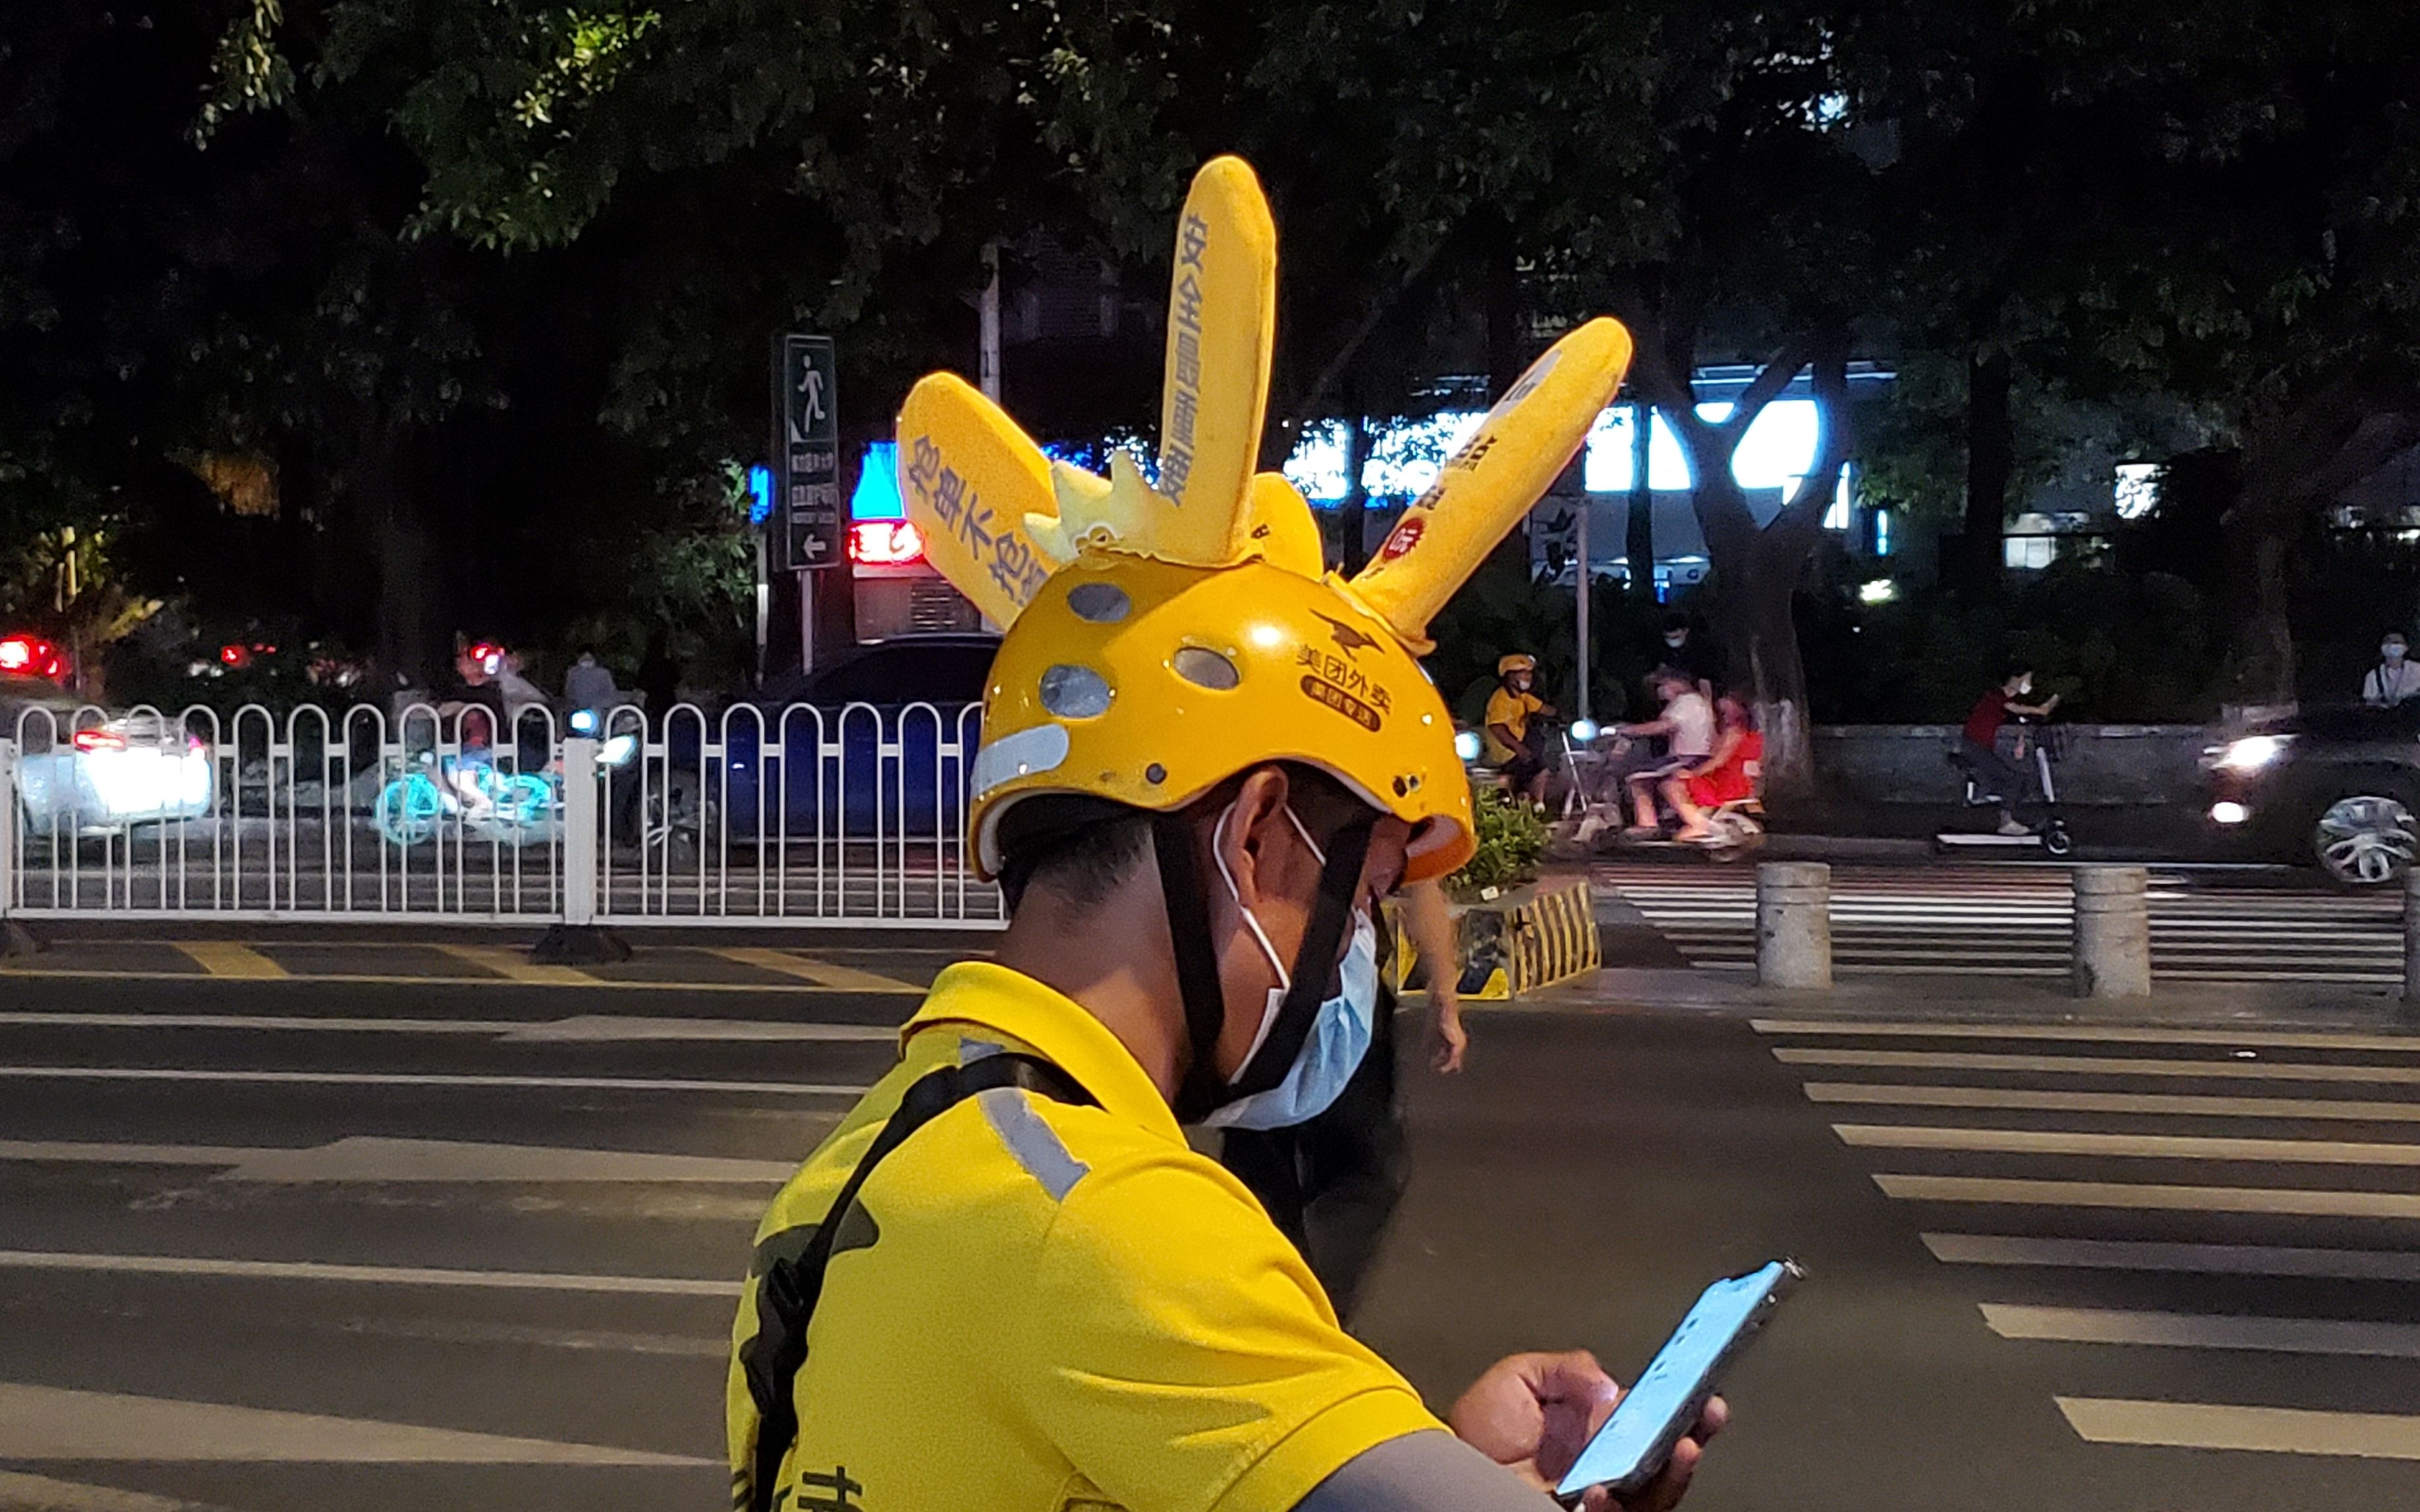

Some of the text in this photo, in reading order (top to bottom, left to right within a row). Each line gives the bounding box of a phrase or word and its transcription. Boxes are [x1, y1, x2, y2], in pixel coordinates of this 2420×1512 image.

[1160, 213, 1209, 507] 安全最重要
[1295, 644, 1392, 715] 美团外卖
